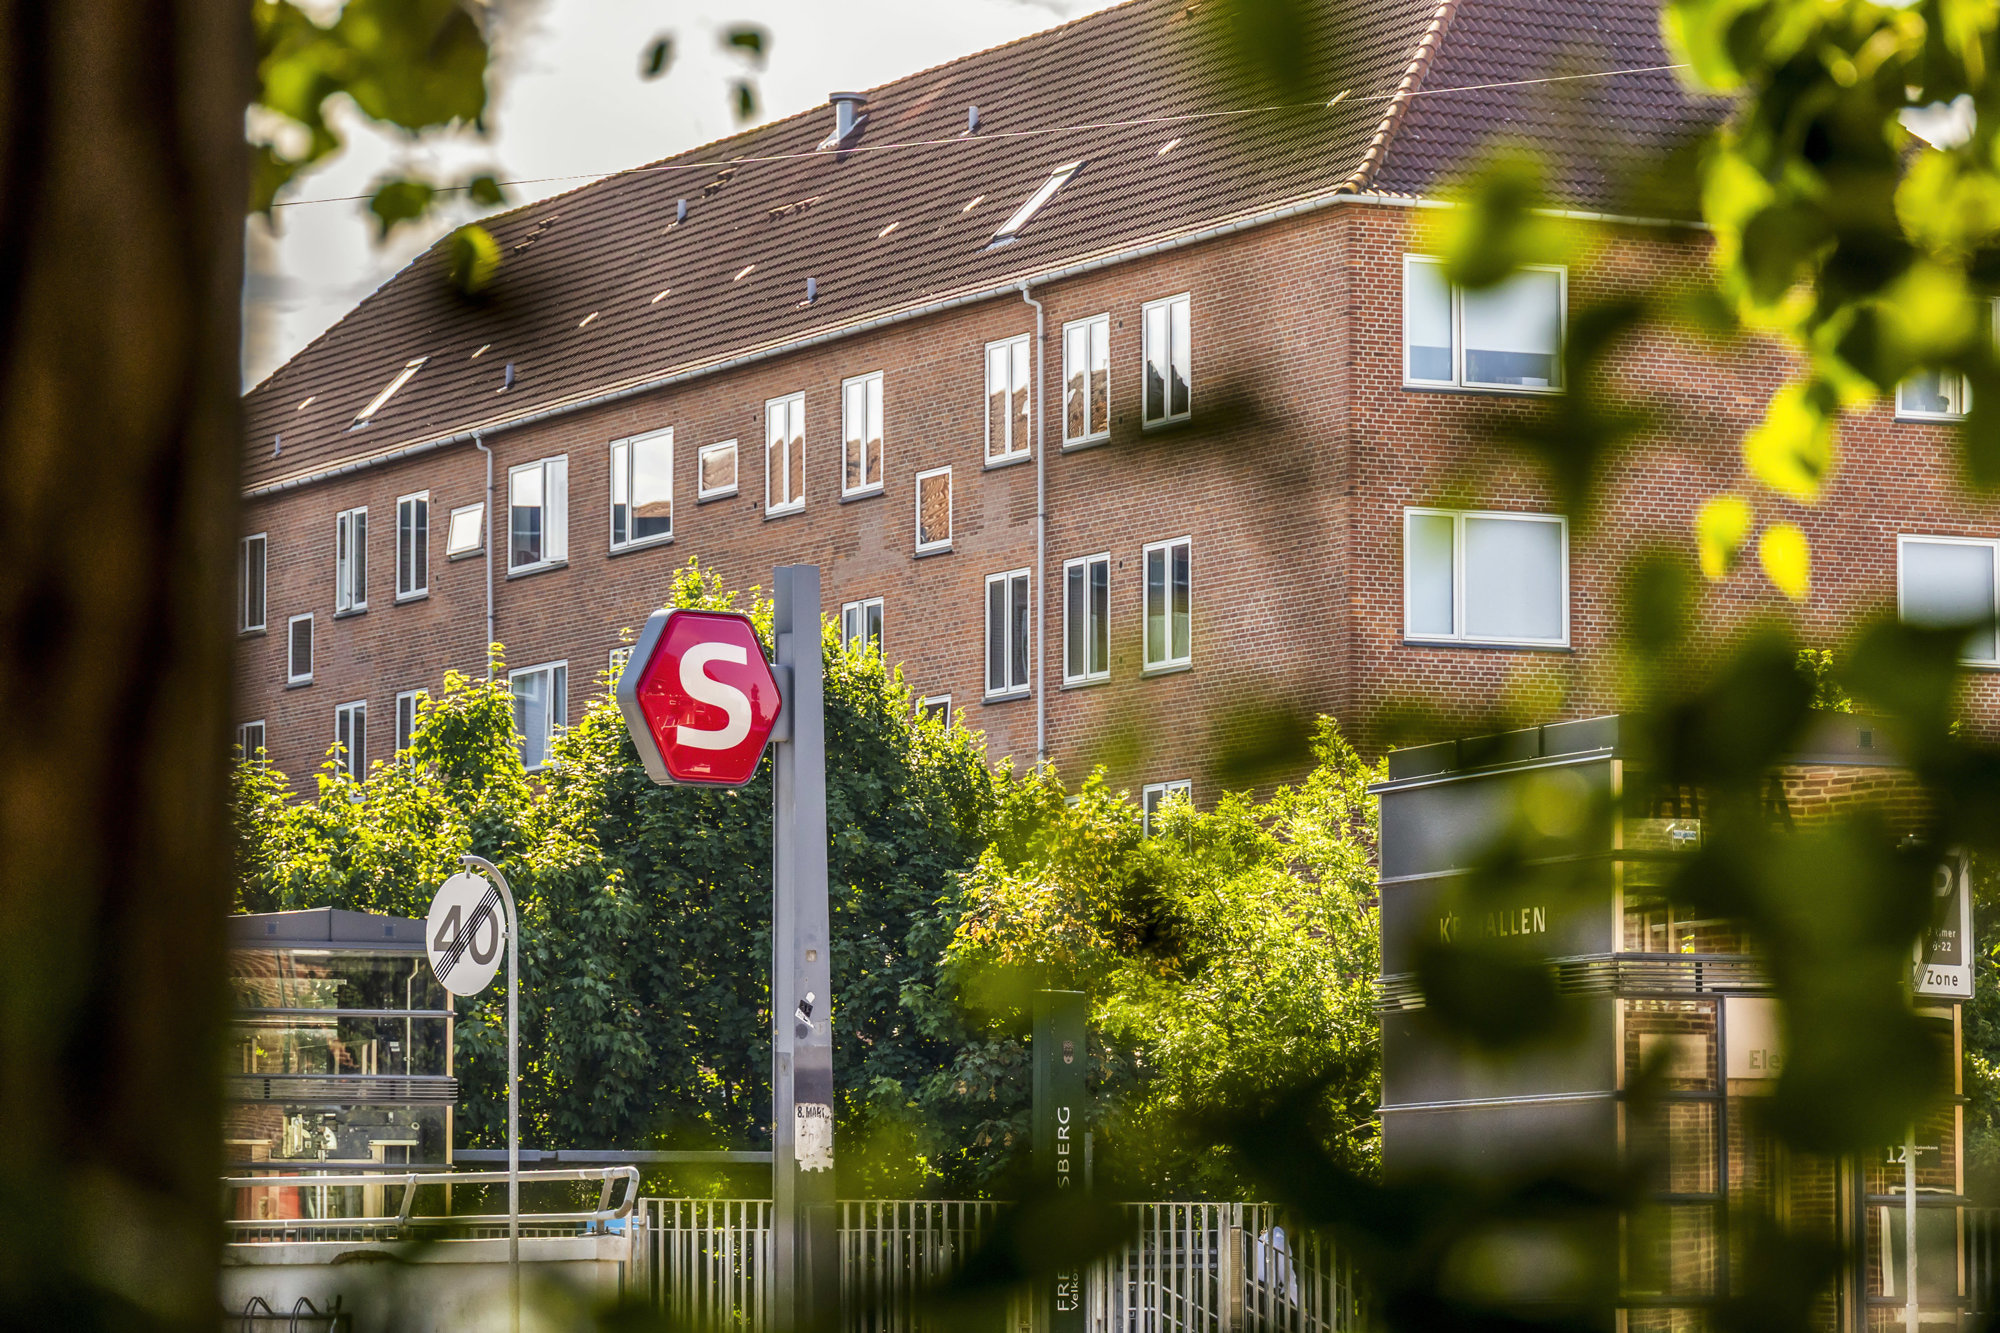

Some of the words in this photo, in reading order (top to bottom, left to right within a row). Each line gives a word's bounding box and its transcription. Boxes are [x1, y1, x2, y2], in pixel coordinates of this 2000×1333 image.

[677, 642, 752, 750] S
[434, 905, 499, 965] 40
[1479, 906, 1546, 937] ALLEN
[1927, 970, 1959, 987] Zone
[1749, 1049, 1780, 1070] Ele
